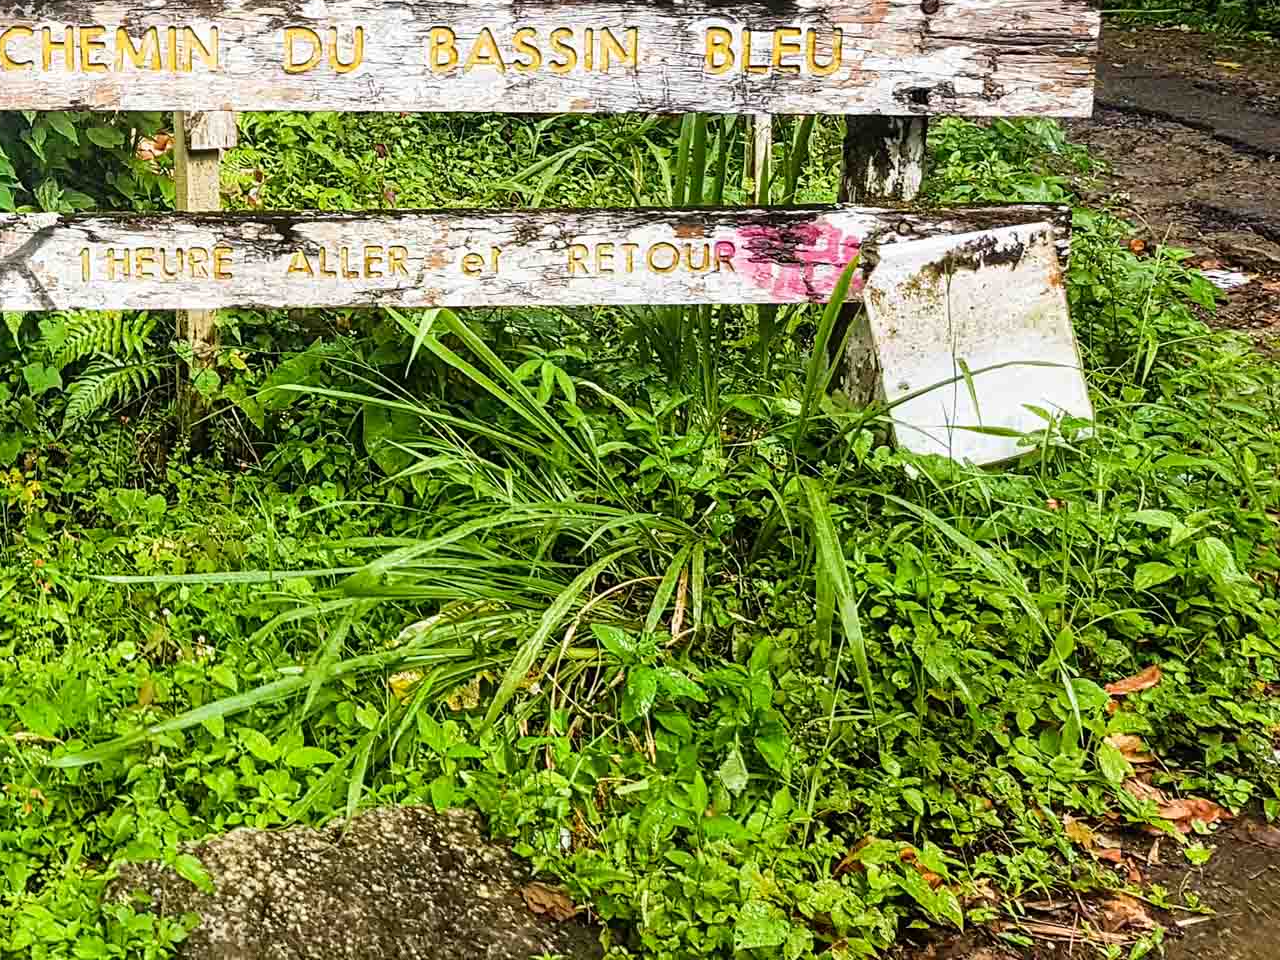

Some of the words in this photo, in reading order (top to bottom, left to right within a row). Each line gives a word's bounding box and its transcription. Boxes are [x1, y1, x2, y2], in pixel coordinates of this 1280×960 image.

[282, 25, 365, 75] DU
[428, 25, 640, 74] BASSIN
[704, 25, 843, 75] BLEU
[78, 246, 91, 282] 1
[106, 243, 234, 281] HEURE
[288, 245, 409, 279] ALLER
[567, 240, 736, 274] RETOUR
